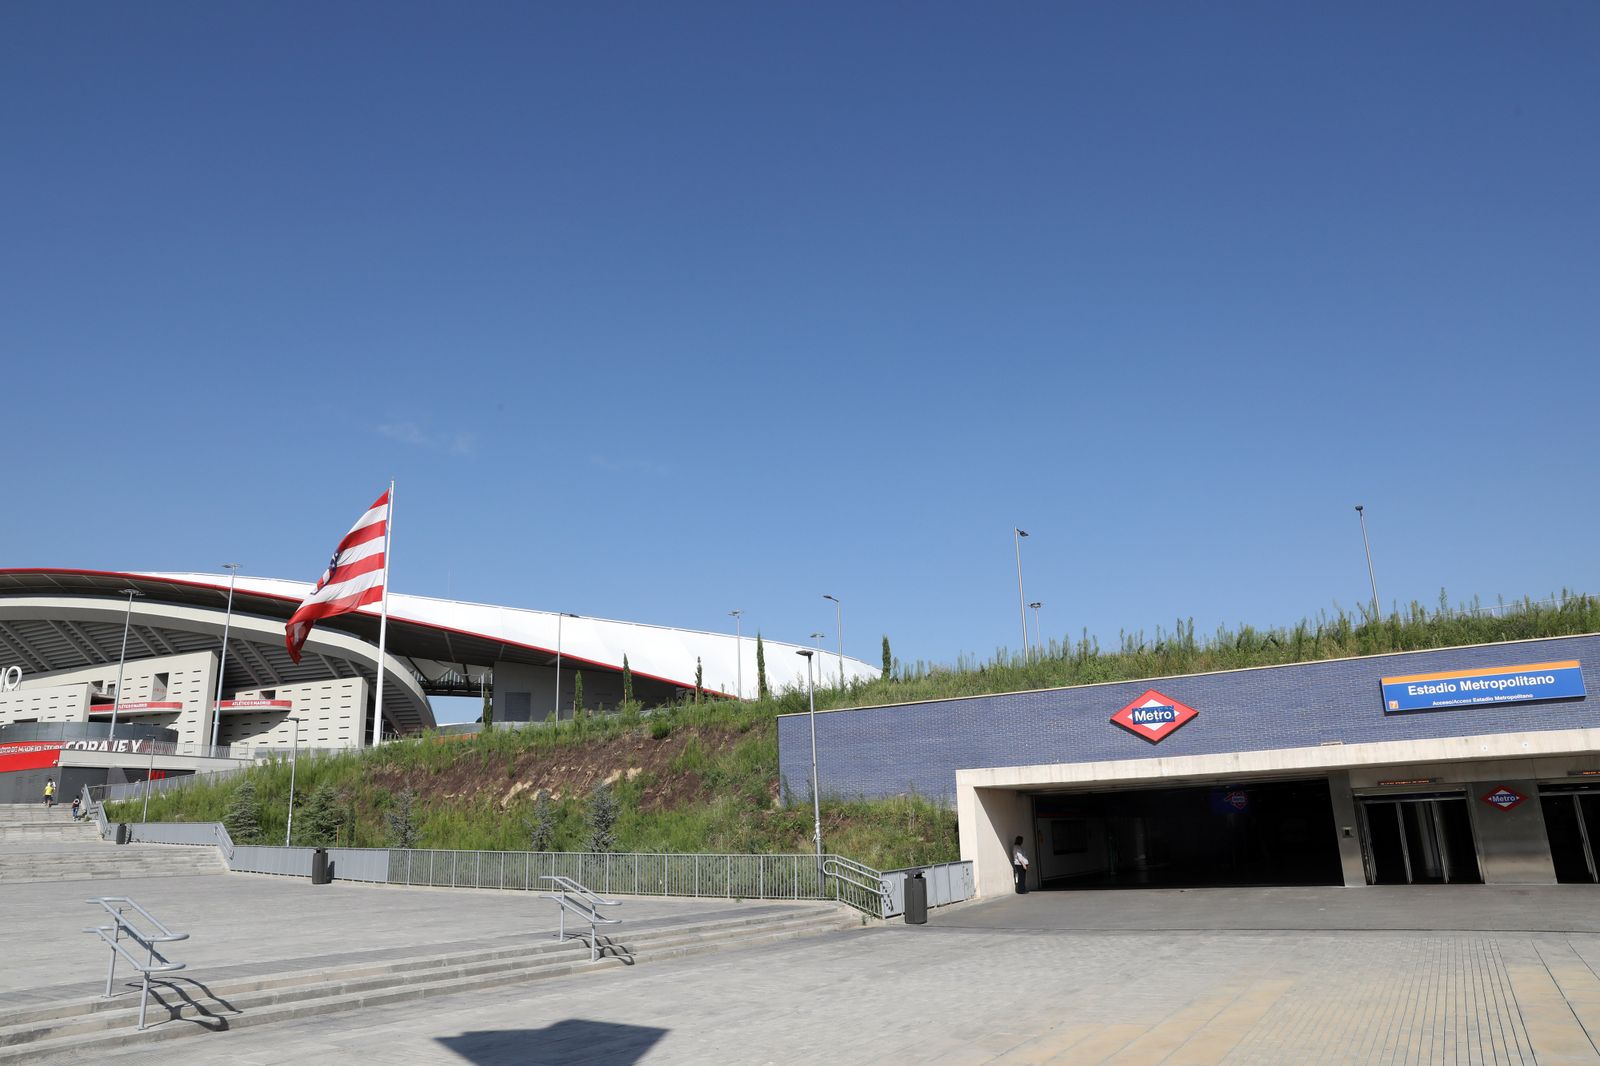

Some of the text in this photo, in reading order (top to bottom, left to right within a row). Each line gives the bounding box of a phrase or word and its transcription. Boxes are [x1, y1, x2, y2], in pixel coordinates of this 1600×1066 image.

[1408, 675, 1555, 695] Estadio Metropolitano
[1472, 695, 1494, 703] Estadio
[1494, 693, 1534, 702] Metropolitano
[1134, 711, 1172, 721] Metro
